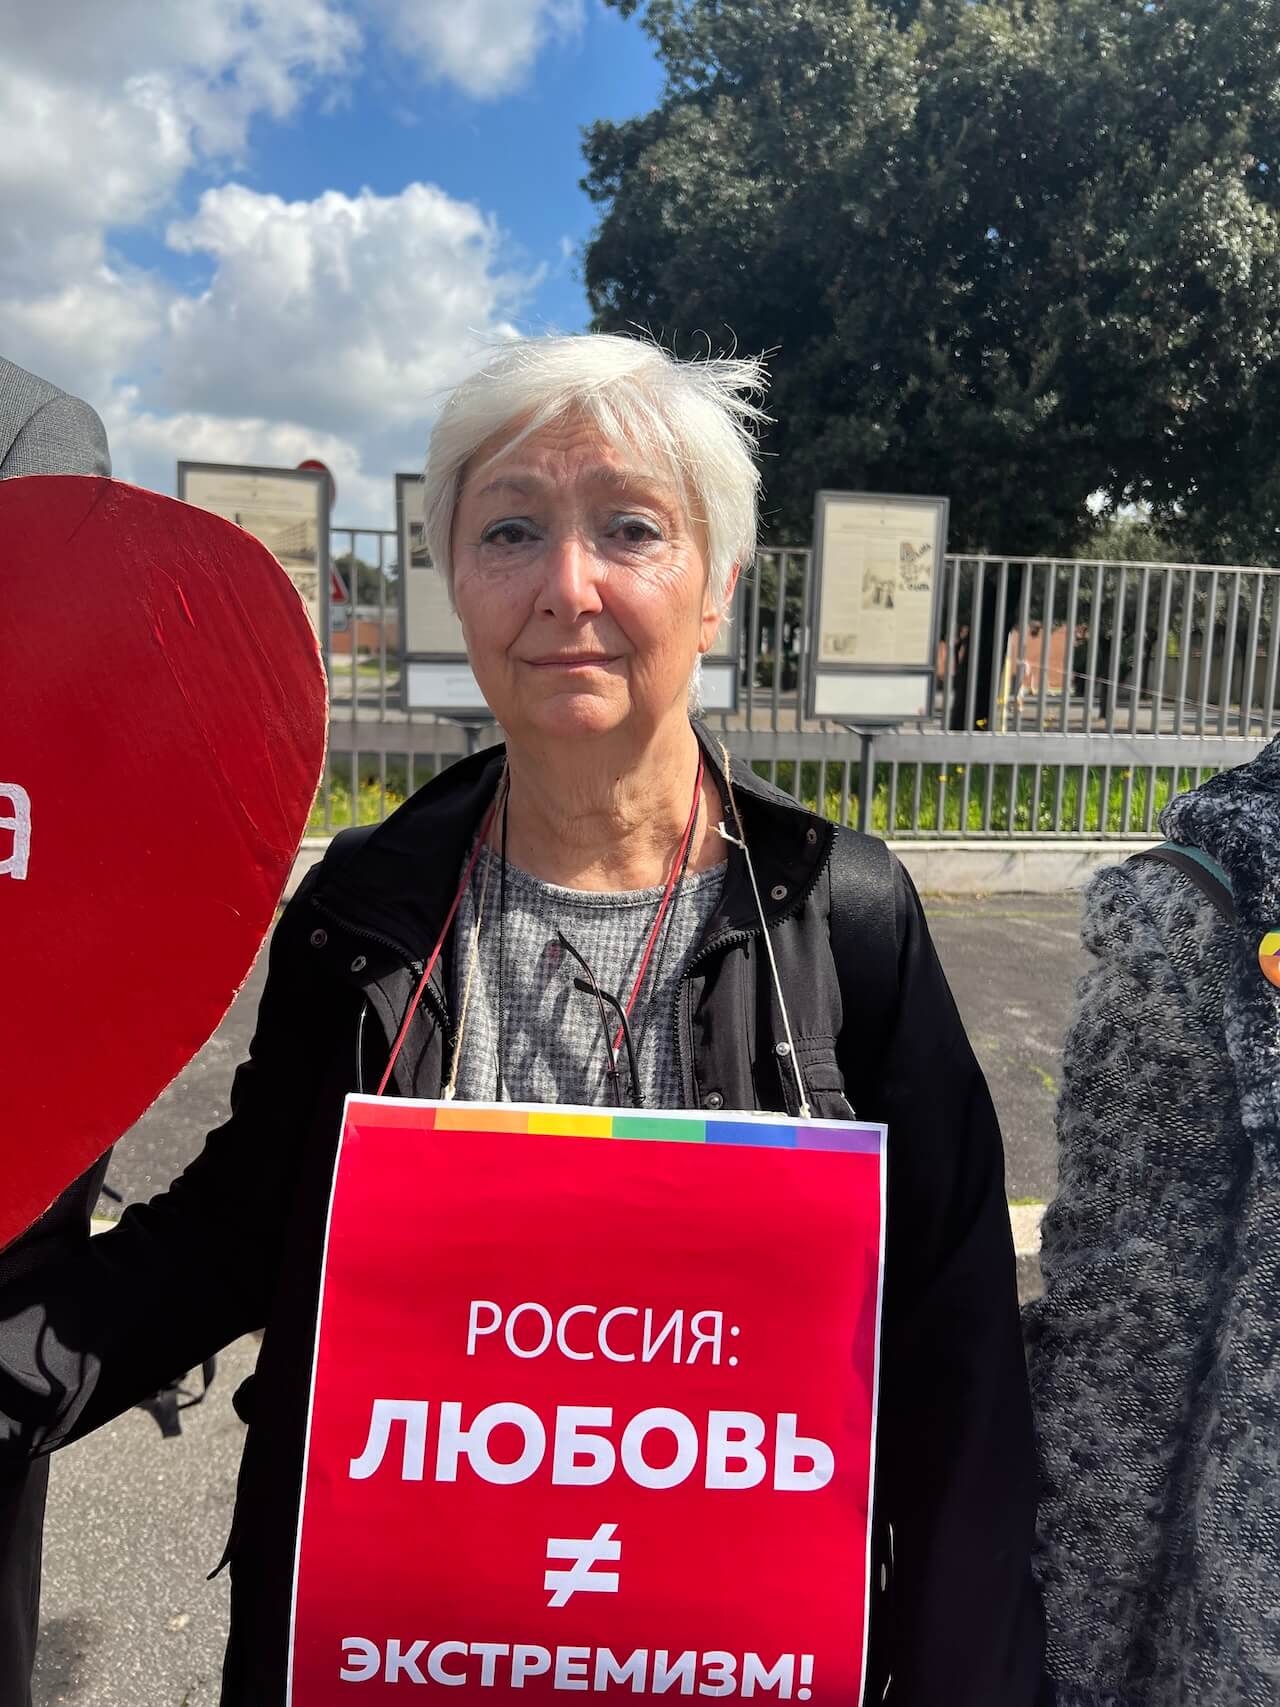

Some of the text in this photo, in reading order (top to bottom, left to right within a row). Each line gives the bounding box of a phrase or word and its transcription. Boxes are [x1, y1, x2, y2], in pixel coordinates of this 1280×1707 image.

[466, 1300, 740, 1366] РОССИЯ:
[348, 1398, 835, 1492] ЛЮБОВЬ
[340, 1636, 815, 1701] ЭКСТРЕМИЗМ!
